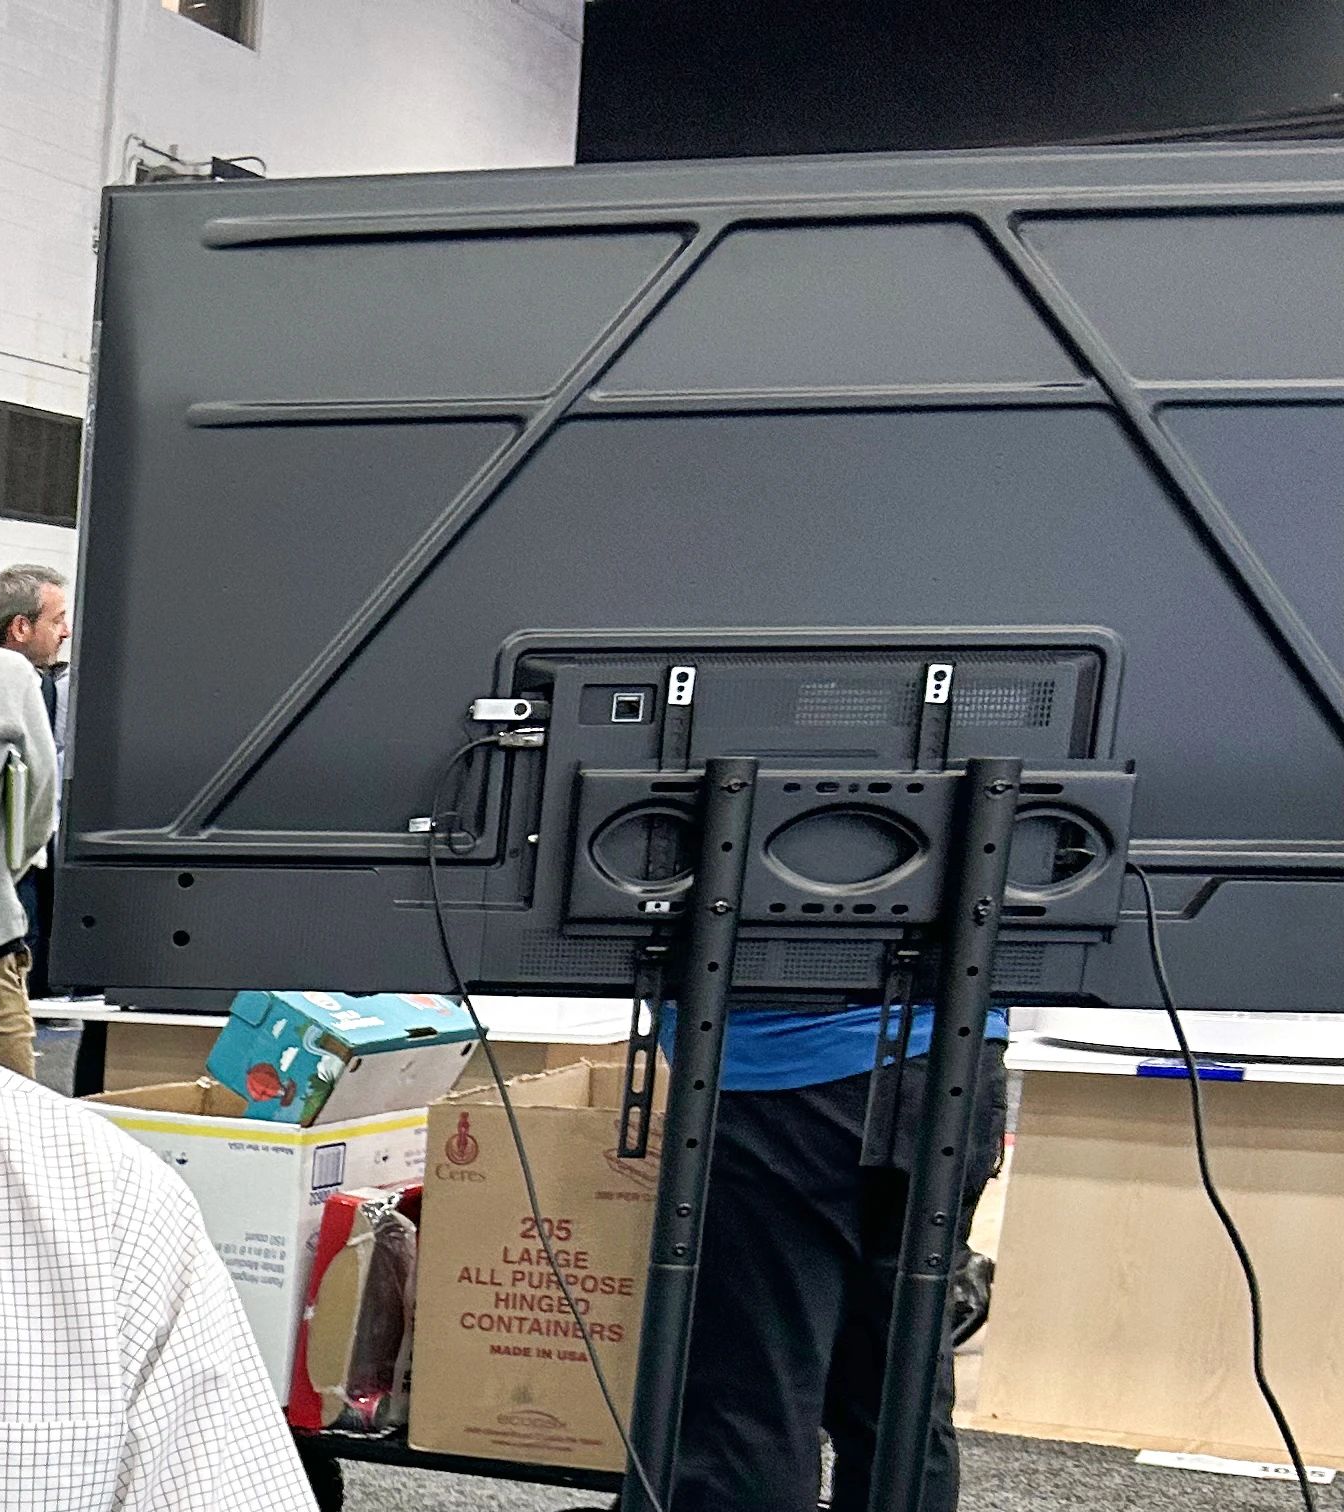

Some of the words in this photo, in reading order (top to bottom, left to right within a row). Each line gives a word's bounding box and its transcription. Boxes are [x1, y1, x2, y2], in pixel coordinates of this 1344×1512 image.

[435, 1163, 487, 1183] Ceres
[520, 1216, 572, 1242] 205
[502, 1245, 589, 1270] LARGE
[457, 1266, 502, 1287] ALL
[512, 1270, 634, 1296] PURPOSE
[494, 1292, 591, 1316] HINGED
[460, 1311, 626, 1343] CONTAINERS
[490, 1344, 532, 1358] MADE
[537, 1347, 553, 1360] IN
[557, 1349, 588, 1363] USA
[1260, 1465, 1326, 1478] 105
